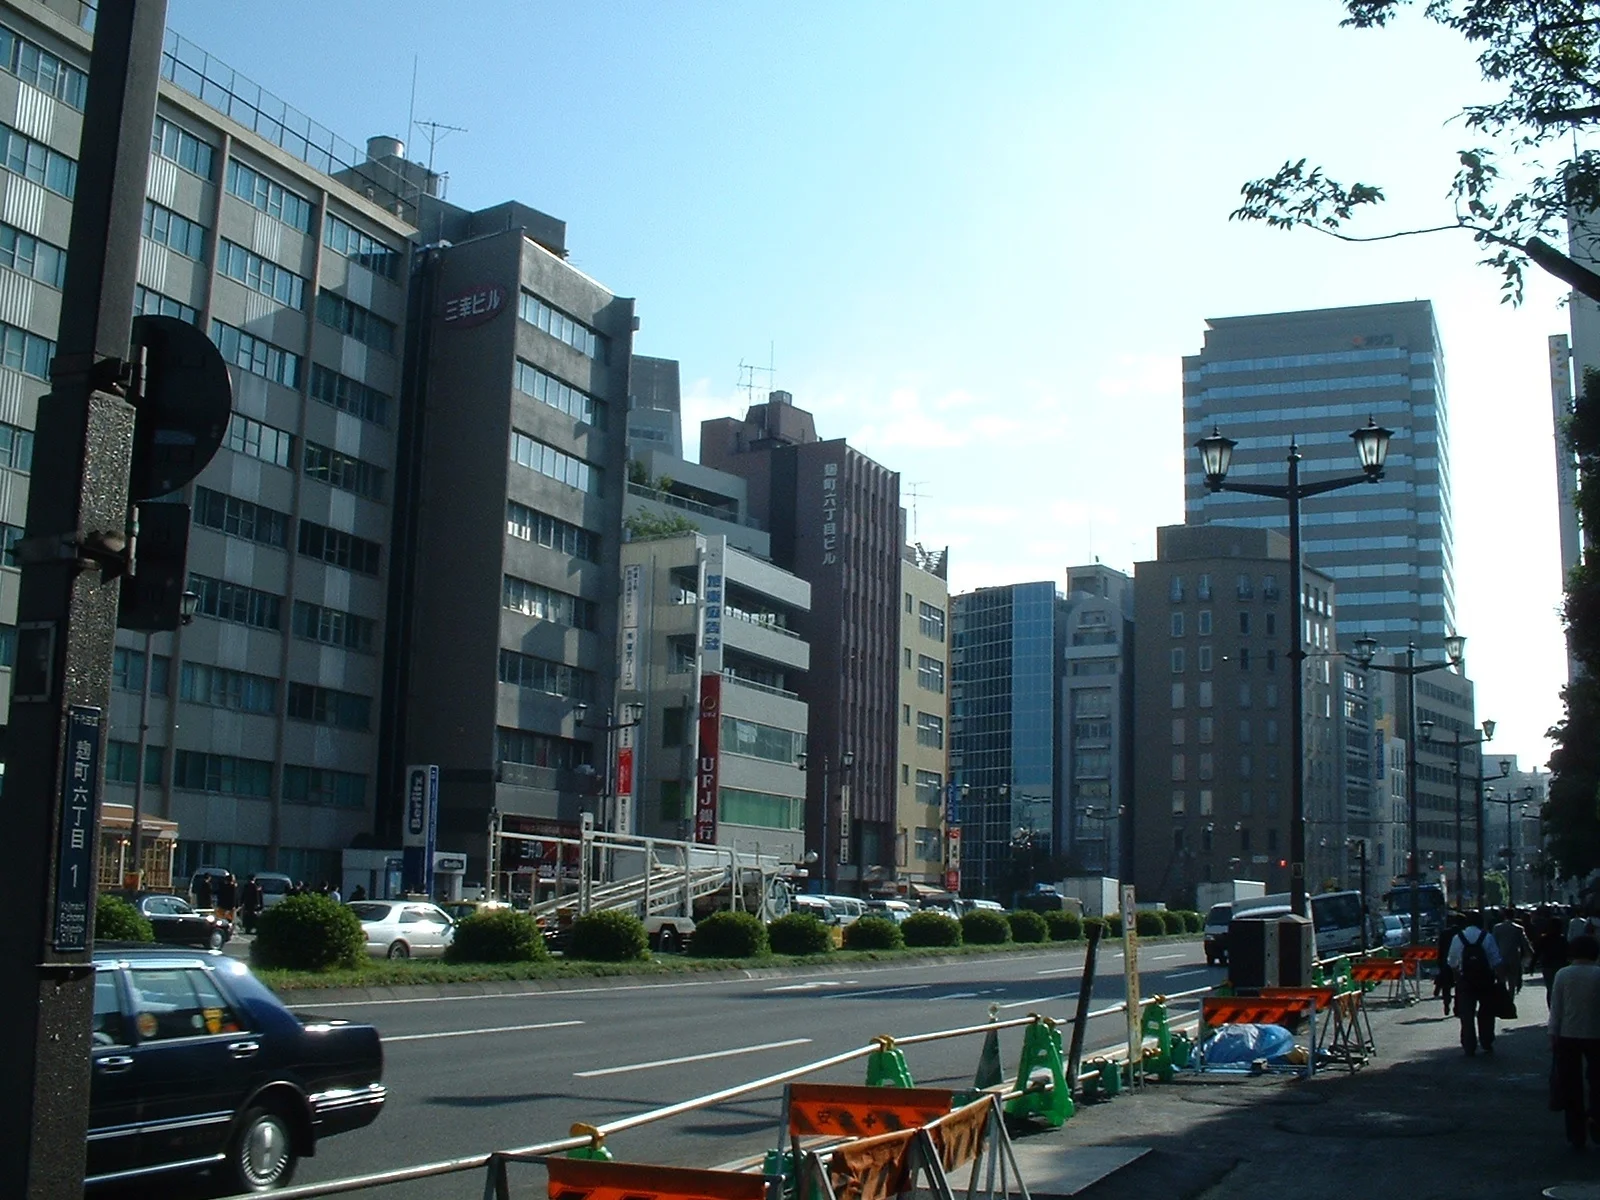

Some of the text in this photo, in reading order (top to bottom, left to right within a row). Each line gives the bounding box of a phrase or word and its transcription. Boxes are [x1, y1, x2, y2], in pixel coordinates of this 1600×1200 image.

[446, 289, 501, 320] 三幸ビル
[70, 740, 92, 888] 麹町六丁目 1
[410, 776, 424, 829] Berlitz
